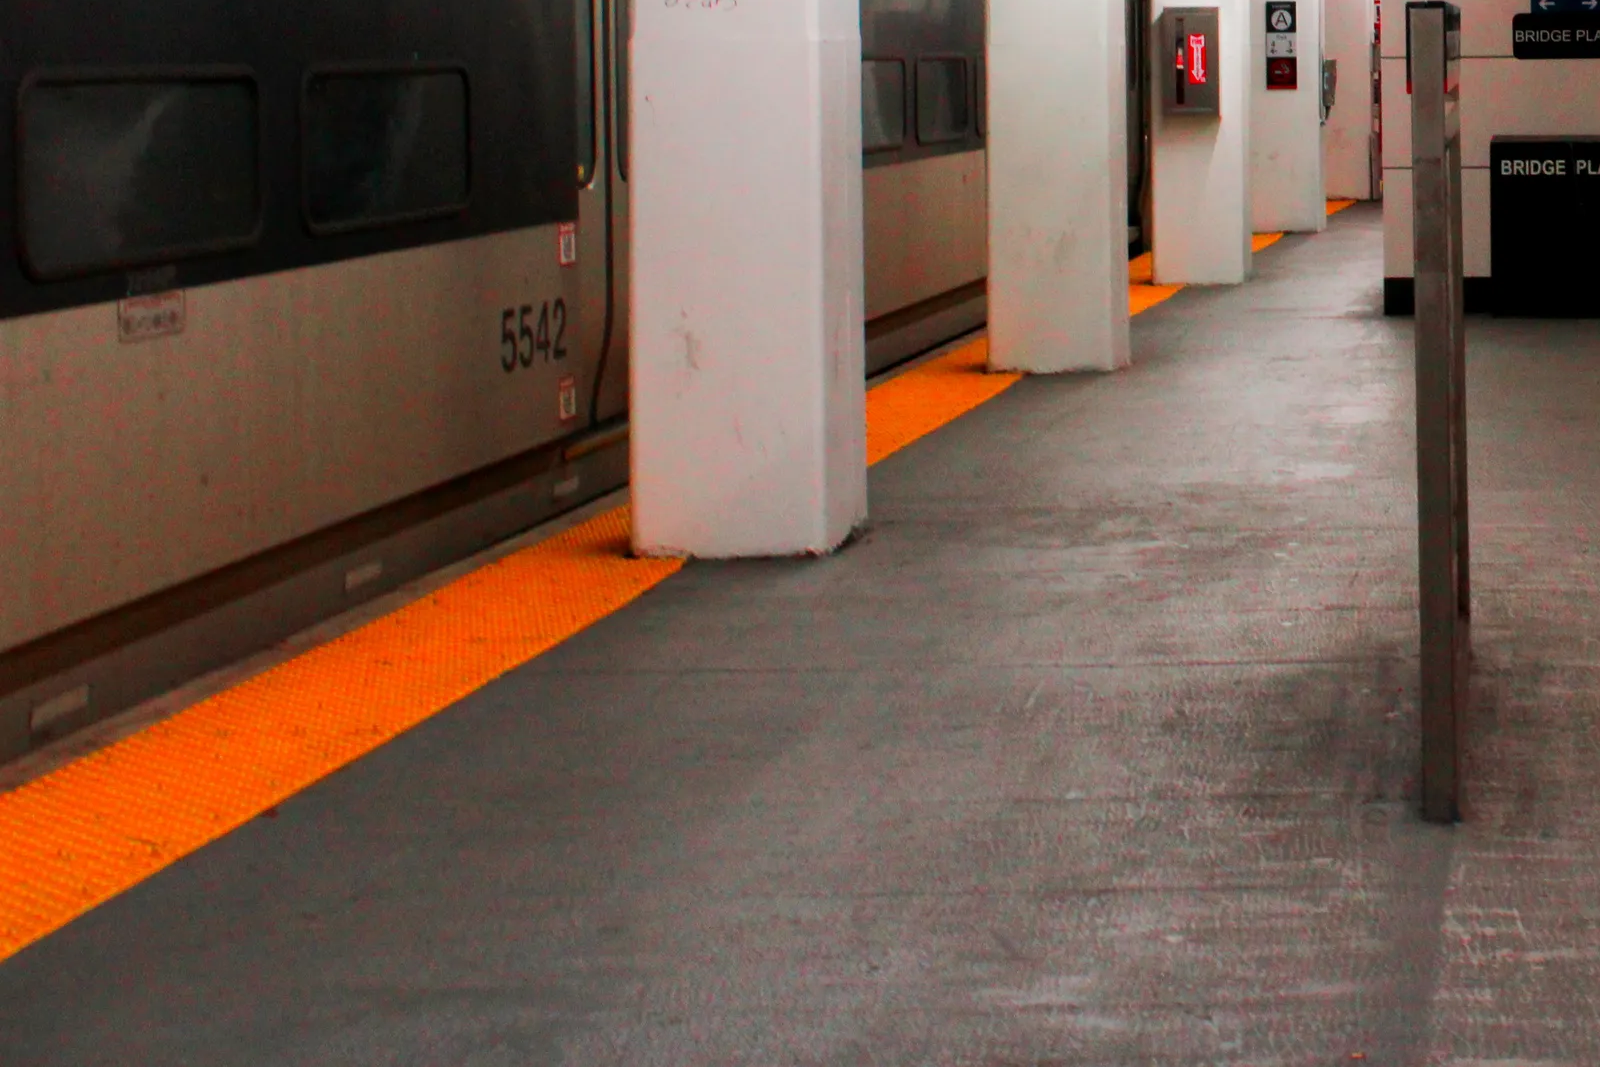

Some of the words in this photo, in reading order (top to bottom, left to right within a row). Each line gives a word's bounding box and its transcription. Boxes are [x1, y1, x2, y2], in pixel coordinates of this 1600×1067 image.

[1515, 30, 1571, 43] BRIDGE
[1500, 159, 1567, 176] BRIDGE
[501, 297, 568, 373] 5542
